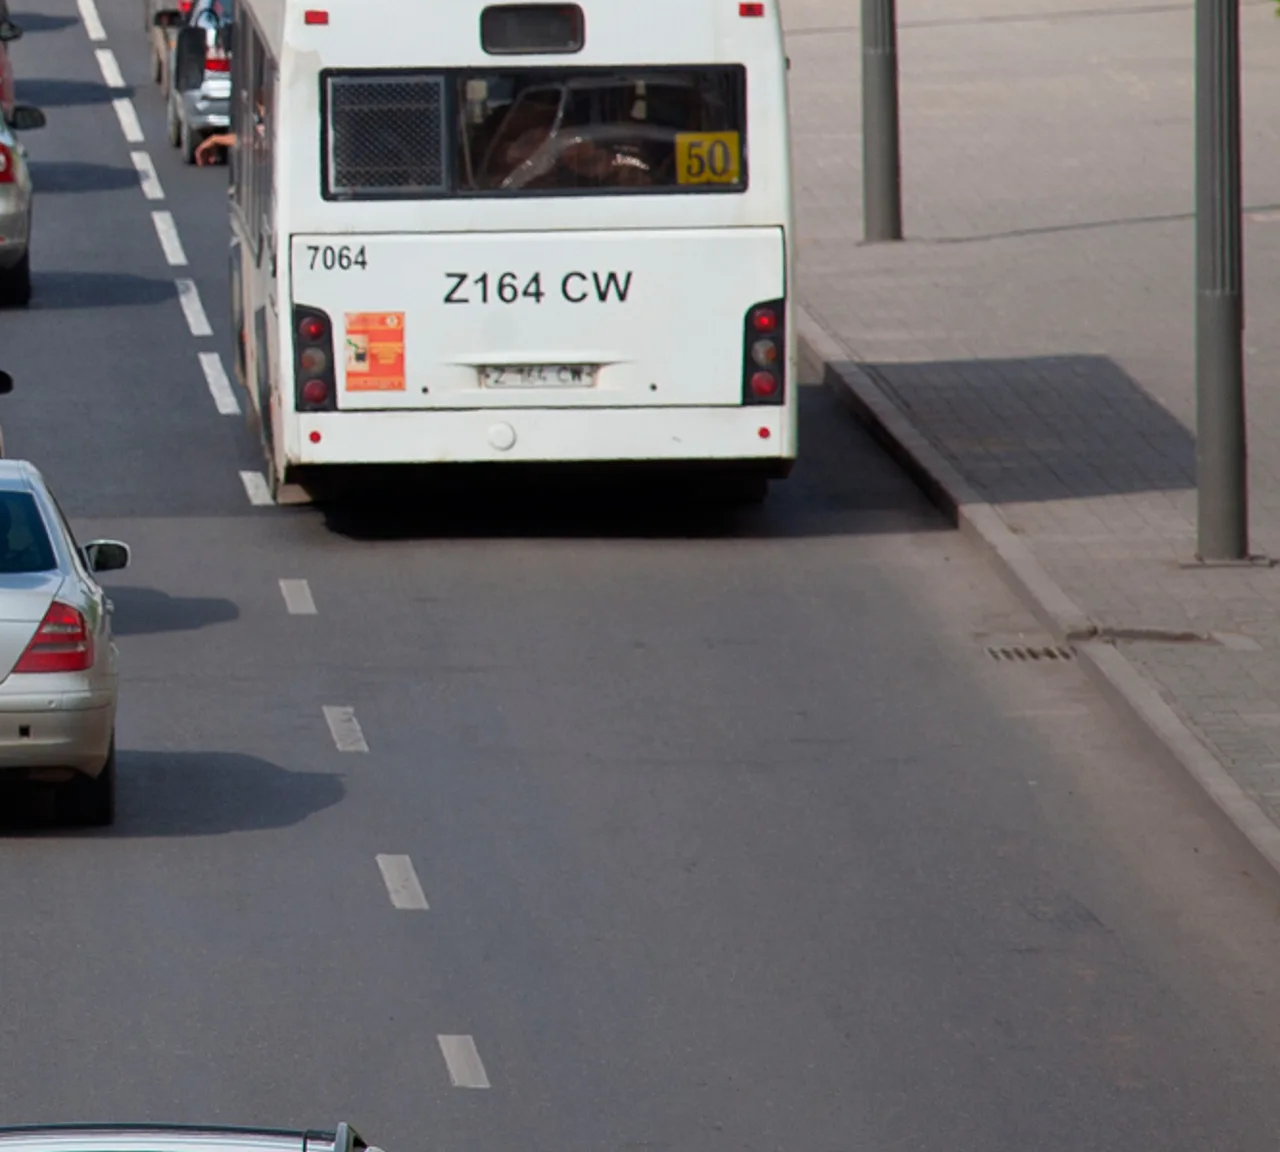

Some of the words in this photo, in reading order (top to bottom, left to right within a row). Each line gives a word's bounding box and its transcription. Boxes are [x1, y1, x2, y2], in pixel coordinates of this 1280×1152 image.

[687, 139, 731, 178] 50
[307, 245, 368, 271] 7064
[443, 271, 545, 304] Z164
[560, 270, 634, 303] CW
